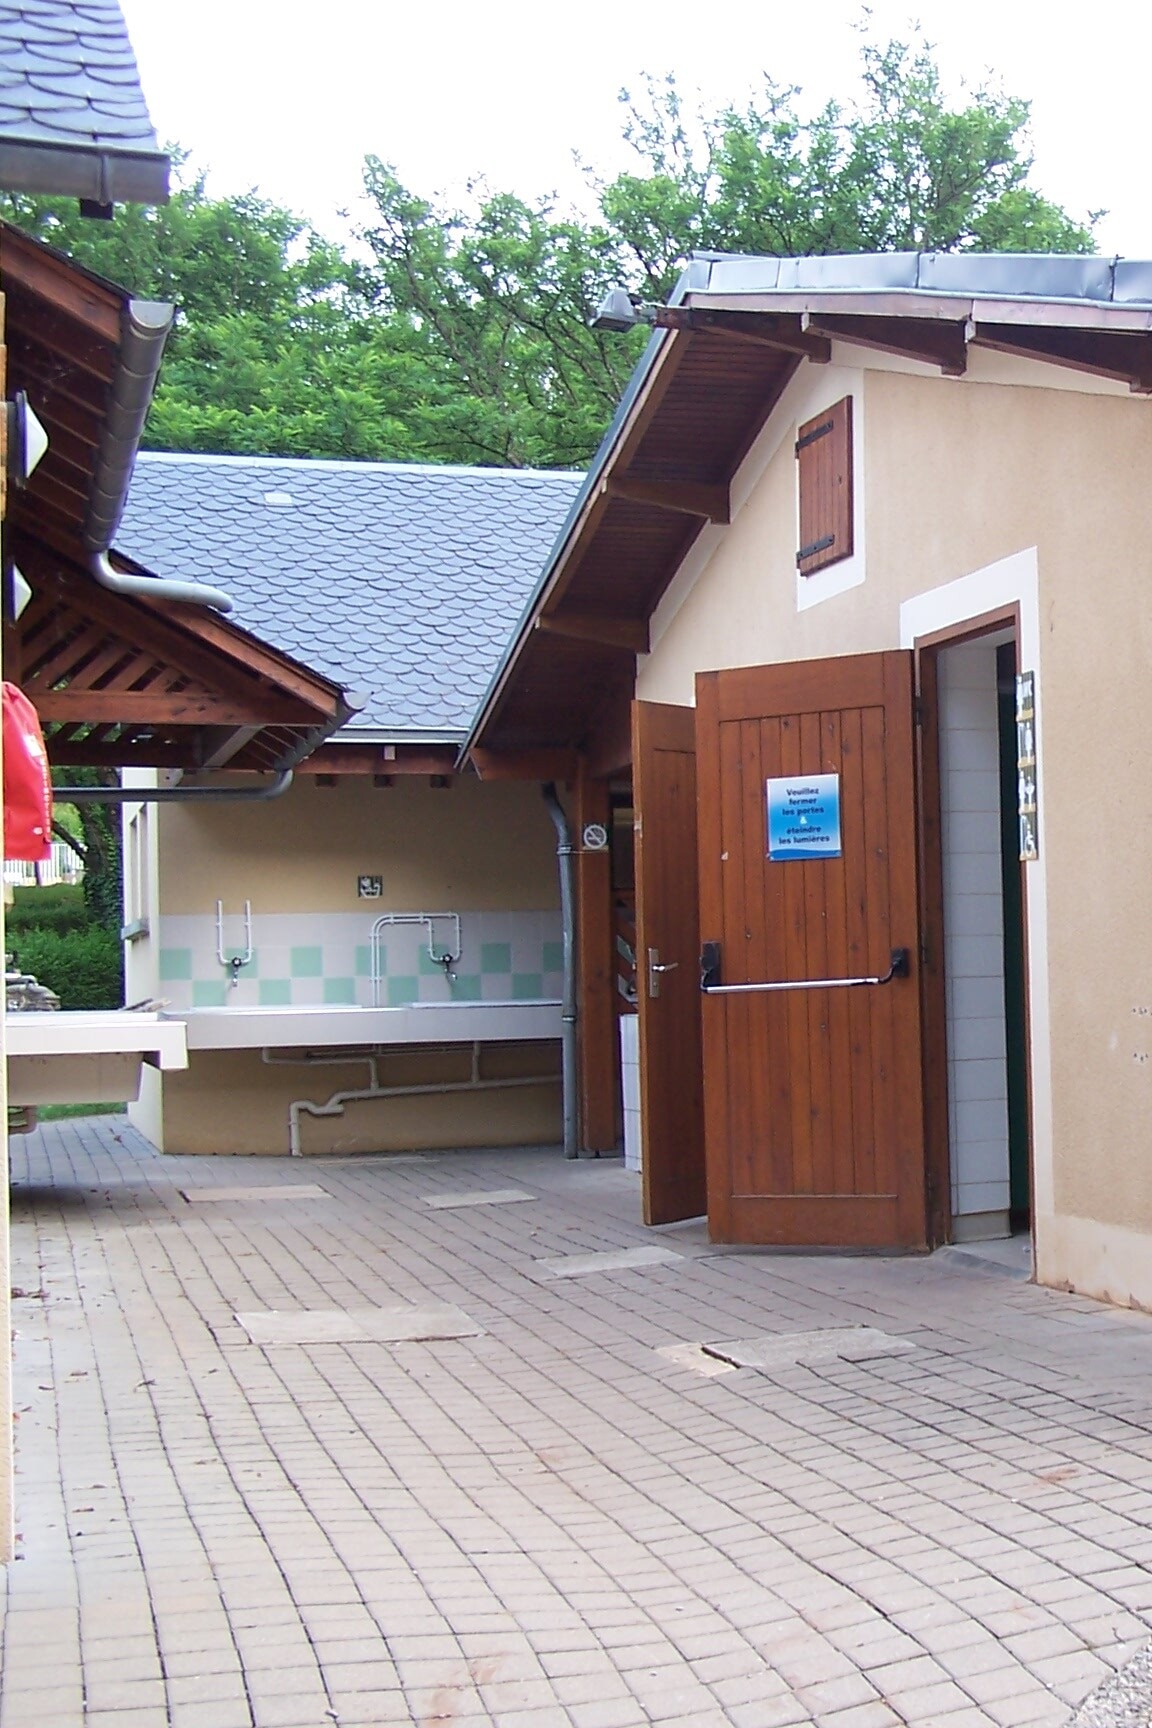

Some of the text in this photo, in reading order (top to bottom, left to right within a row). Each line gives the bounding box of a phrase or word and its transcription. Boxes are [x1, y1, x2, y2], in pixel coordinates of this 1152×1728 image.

[786, 788, 819, 796] Veuillez
[789, 798, 817, 806] fermer
[782, 806, 824, 817] les portes
[786, 825, 822, 834] éteindre
[779, 834, 830, 845] les lumières
